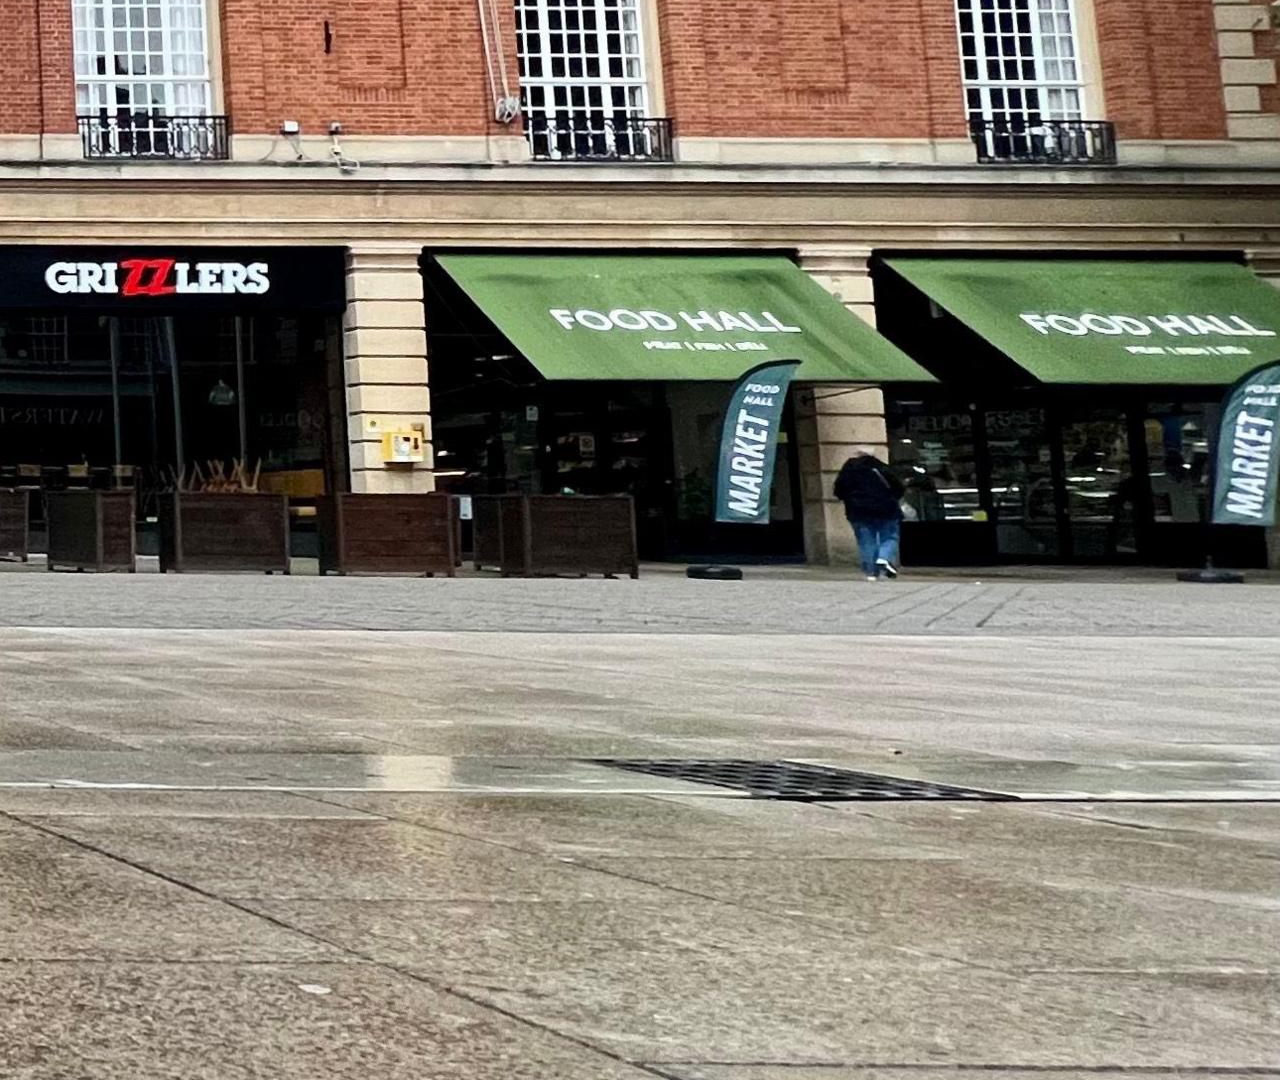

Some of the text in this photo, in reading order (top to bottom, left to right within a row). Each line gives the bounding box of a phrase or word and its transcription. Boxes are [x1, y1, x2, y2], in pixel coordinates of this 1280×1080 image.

[44, 259, 270, 296] GRIZZLERS
[549, 308, 802, 332] FOOD HALL
[1019, 313, 1276, 336] FOOD HALL
[728, 408, 769, 516] MARKET
[1225, 410, 1274, 519] MARKET
